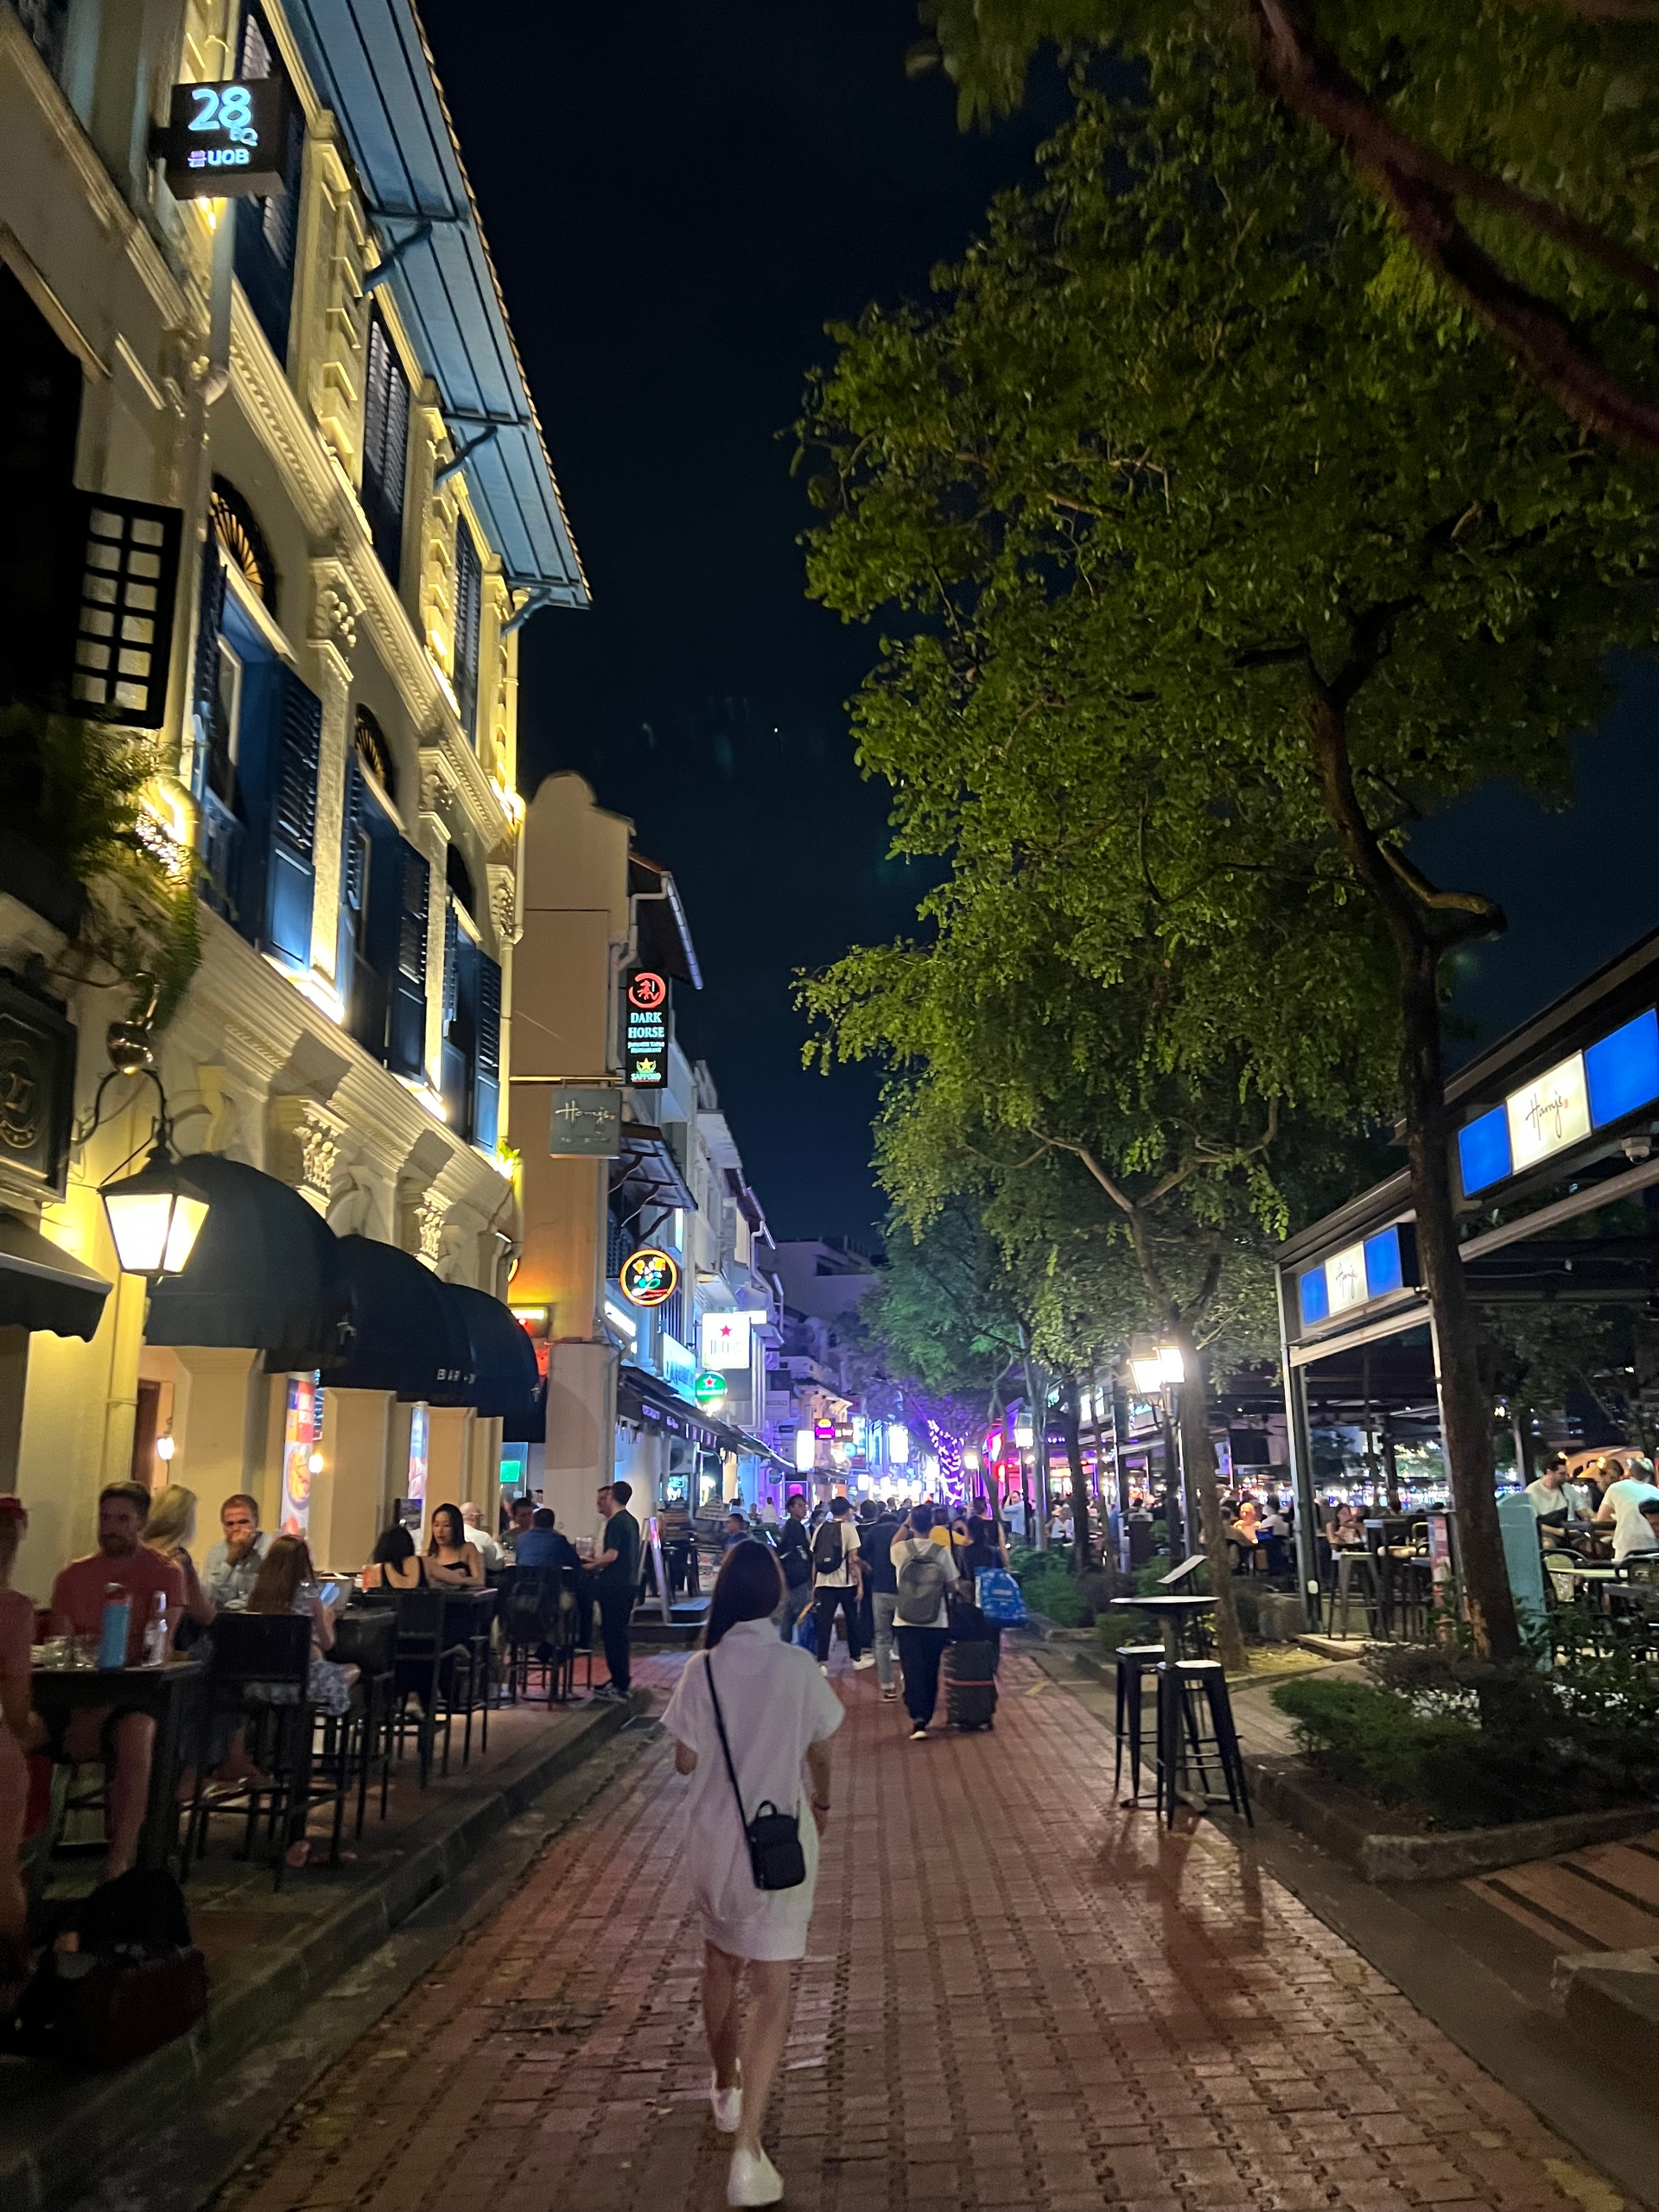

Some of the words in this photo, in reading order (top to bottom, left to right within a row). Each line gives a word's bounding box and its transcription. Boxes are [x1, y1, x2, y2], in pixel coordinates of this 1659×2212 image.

[207, 149, 250, 166] UOB
[630, 1012, 663, 1024] DARK
[627, 1027, 665, 1039] HORSE
